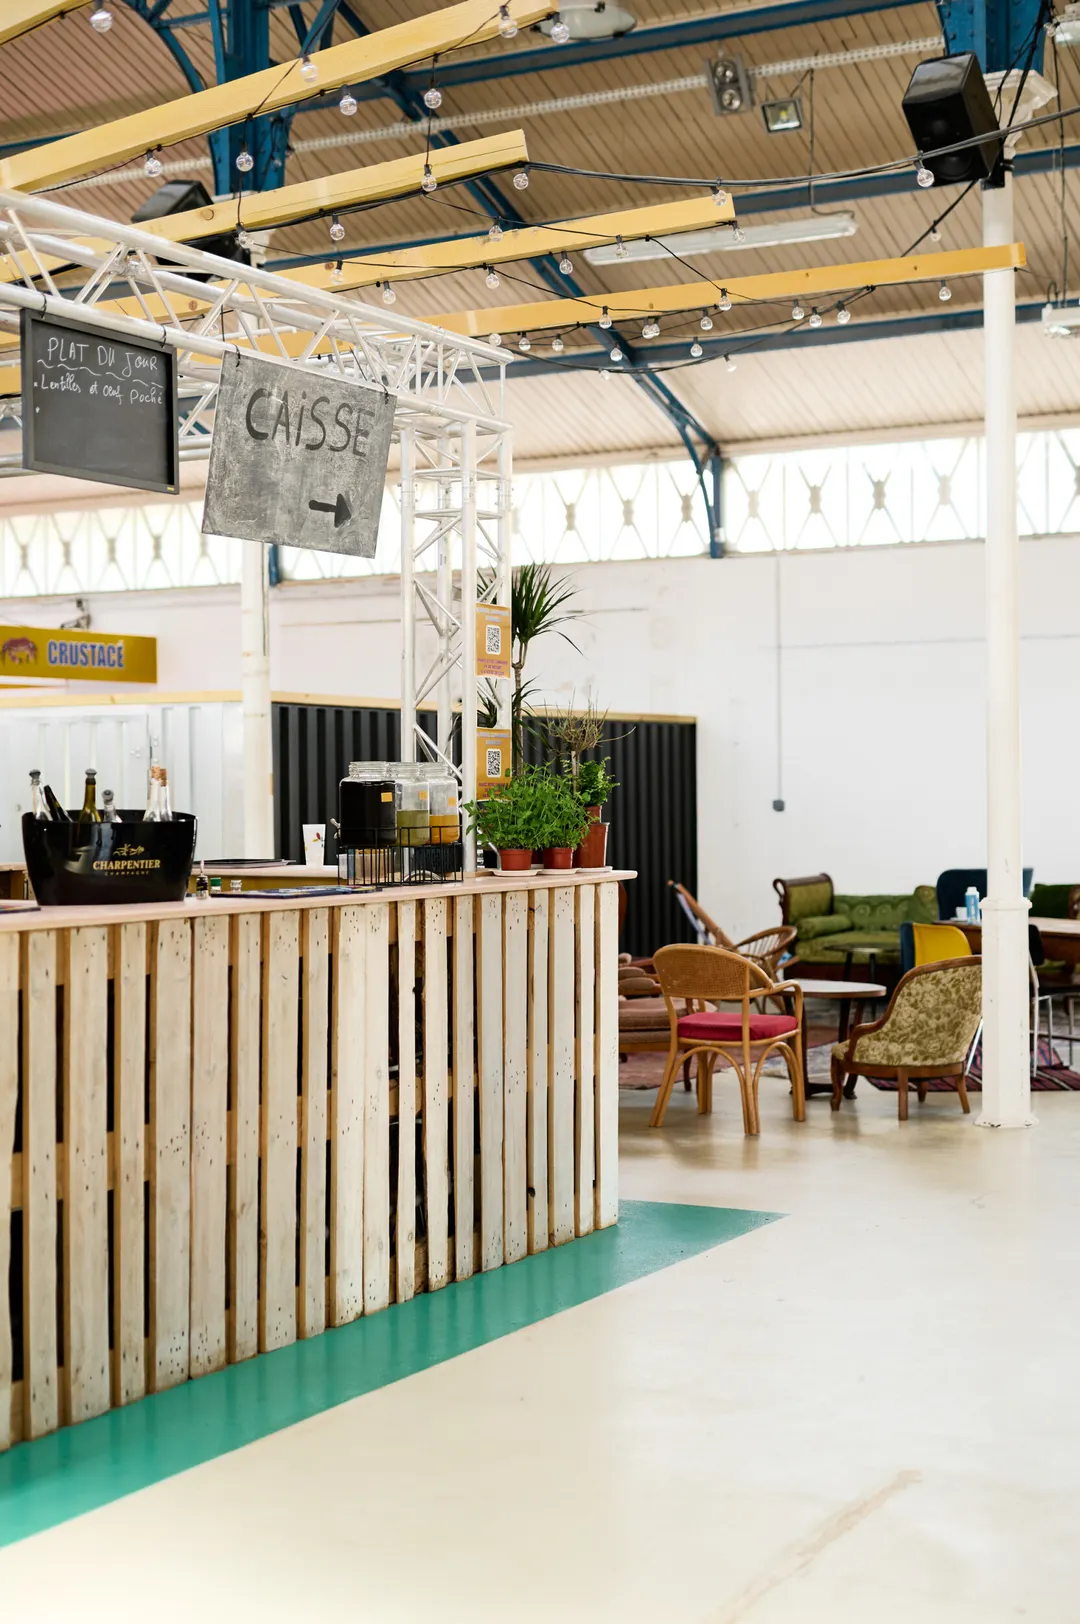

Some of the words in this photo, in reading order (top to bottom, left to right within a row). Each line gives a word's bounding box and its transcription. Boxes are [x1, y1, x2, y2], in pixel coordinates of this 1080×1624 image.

[47, 337, 90, 362] PLAT
[97, 345, 116, 367] DU
[41, 372, 82, 394] Lentilles
[89, 381, 98, 395] et
[92, 859, 161, 871] CHARPENTIER
